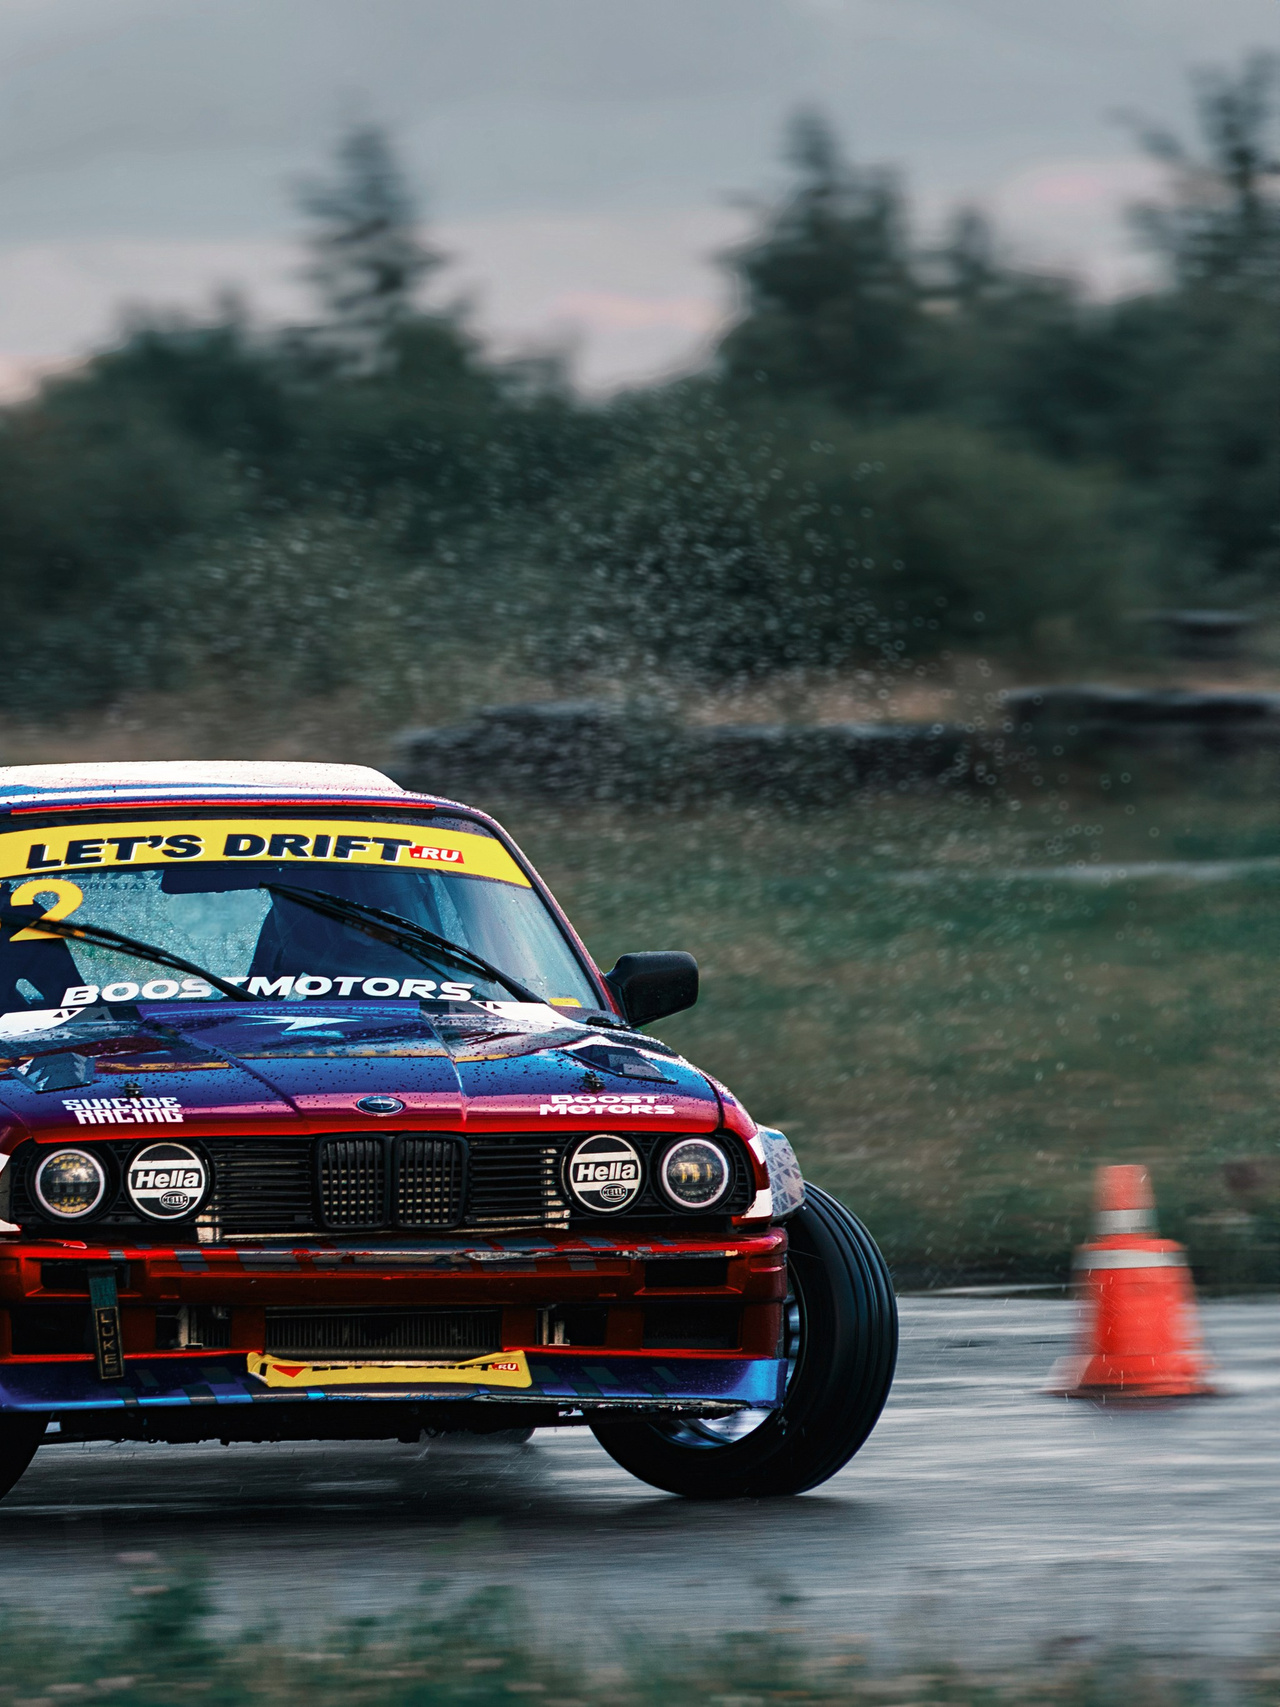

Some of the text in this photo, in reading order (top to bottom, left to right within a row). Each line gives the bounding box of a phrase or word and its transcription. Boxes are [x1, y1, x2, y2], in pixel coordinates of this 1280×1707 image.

[26, 834, 205, 870] LET'S
[551, 1095, 660, 1104] BOOST
[74, 1108, 184, 1124] RACING
[539, 1104, 675, 1115] MOTORS
[135, 1170, 200, 1189] Hella
[577, 1162, 636, 1182] Hella
[100, 1313, 118, 1364] LUKE
